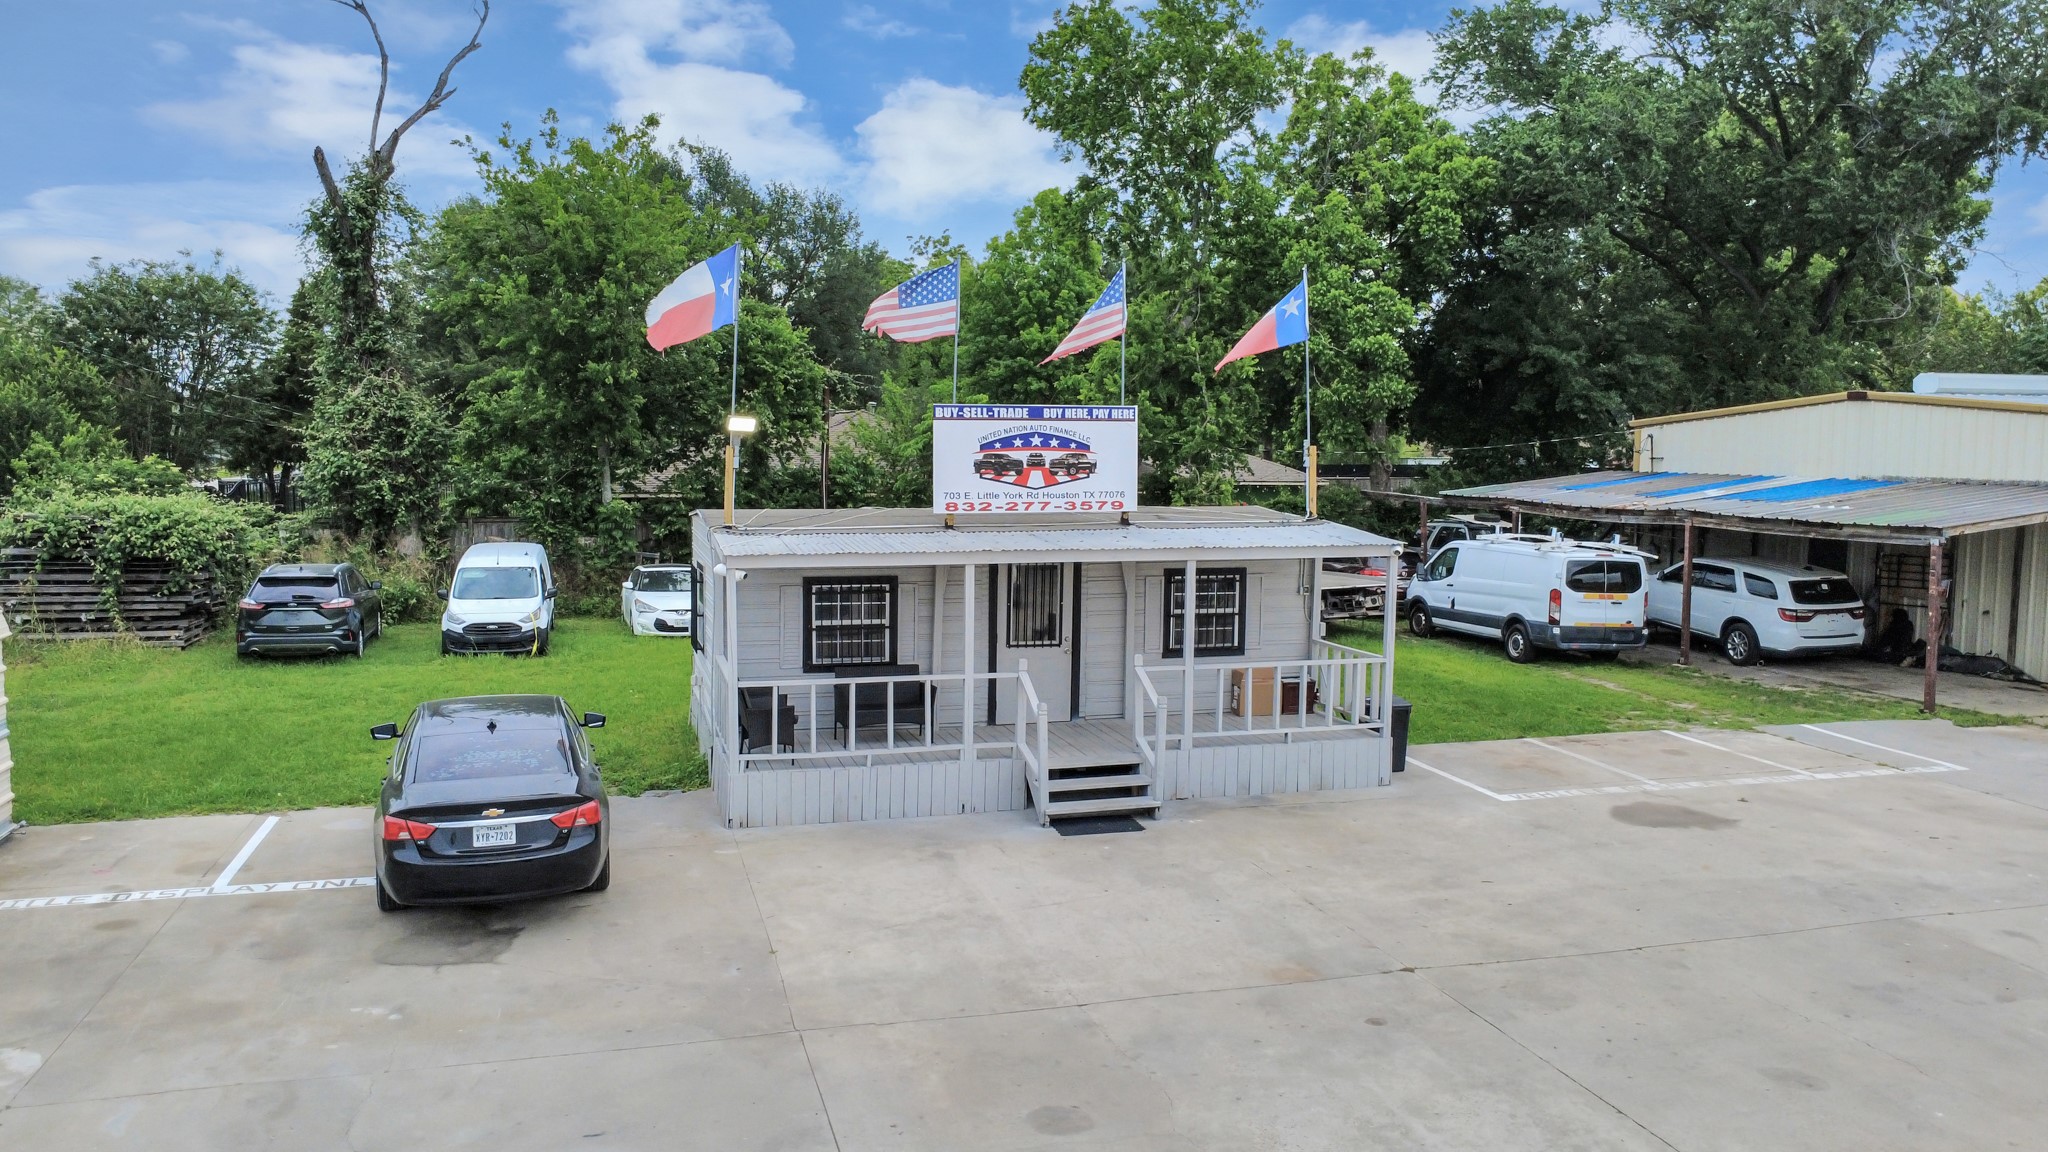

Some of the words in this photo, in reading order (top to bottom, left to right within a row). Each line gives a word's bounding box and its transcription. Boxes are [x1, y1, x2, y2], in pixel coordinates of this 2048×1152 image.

[935, 407, 1029, 418] BUY-SELL-TRADE
[1043, 408, 1063, 419] BUY
[1065, 408, 1091, 420] HERE,
[1092, 408, 1110, 419] PAY
[1112, 408, 1135, 419] HERE
[977, 431, 1001, 443] UNITED
[1003, 425, 1028, 435] NATION
[1029, 424, 1048, 432] AUTO
[1049, 425, 1077, 437] FINANCE
[1078, 433, 1091, 443] LLC
[943, 491, 961, 500] 703
[964, 491, 974, 500] E.
[977, 491, 1000, 500] Little
[1002, 491, 1024, 500] York
[1027, 491, 1039, 500] Rd
[1042, 491, 1080, 499] Houston
[1083, 490, 1095, 499] TX
[1098, 490, 1126, 499] 77076
[945, 501, 1124, 512] 832-277-3579
[110, 884, 277, 902] DISPLAY
